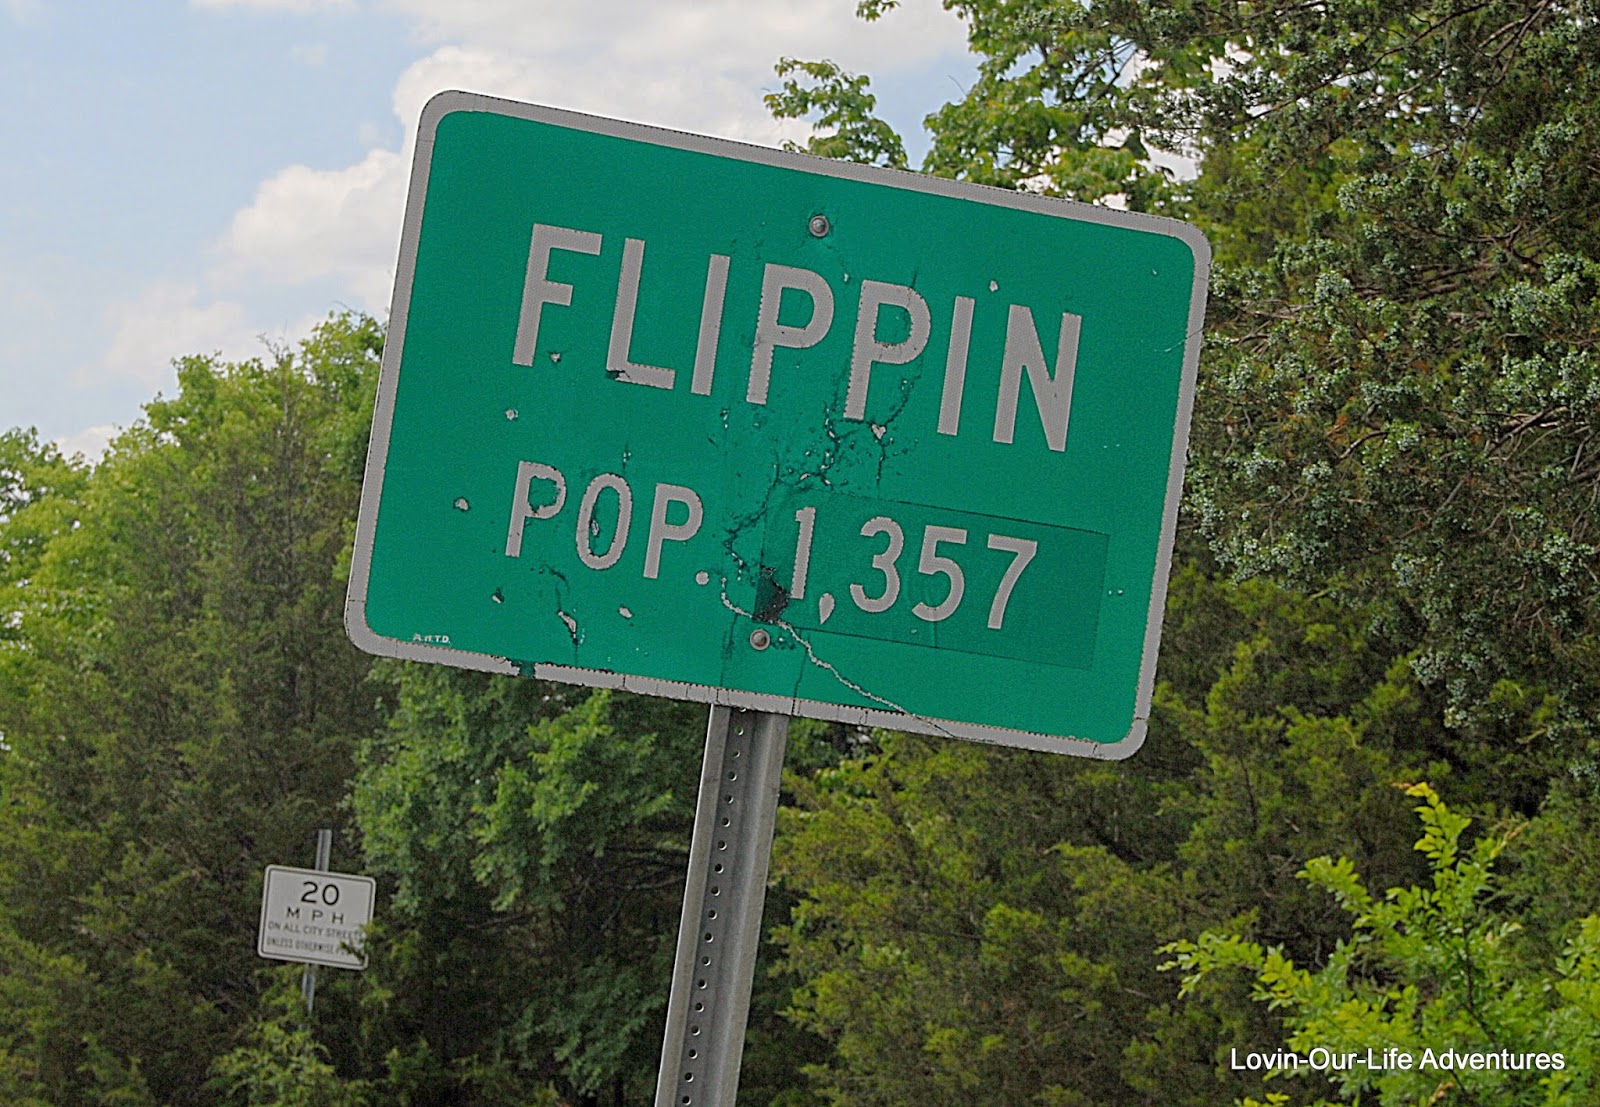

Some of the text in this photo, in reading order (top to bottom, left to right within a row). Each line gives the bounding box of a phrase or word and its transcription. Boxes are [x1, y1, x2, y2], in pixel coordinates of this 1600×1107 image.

[512, 223, 1083, 452] FLIPPIN
[505, 460, 1038, 630] POP. 1,357
[268, 921, 281, 930] ON
[283, 922, 300, 934] ALL
[303, 925, 323, 937] CITY
[301, 881, 340, 906] 20
